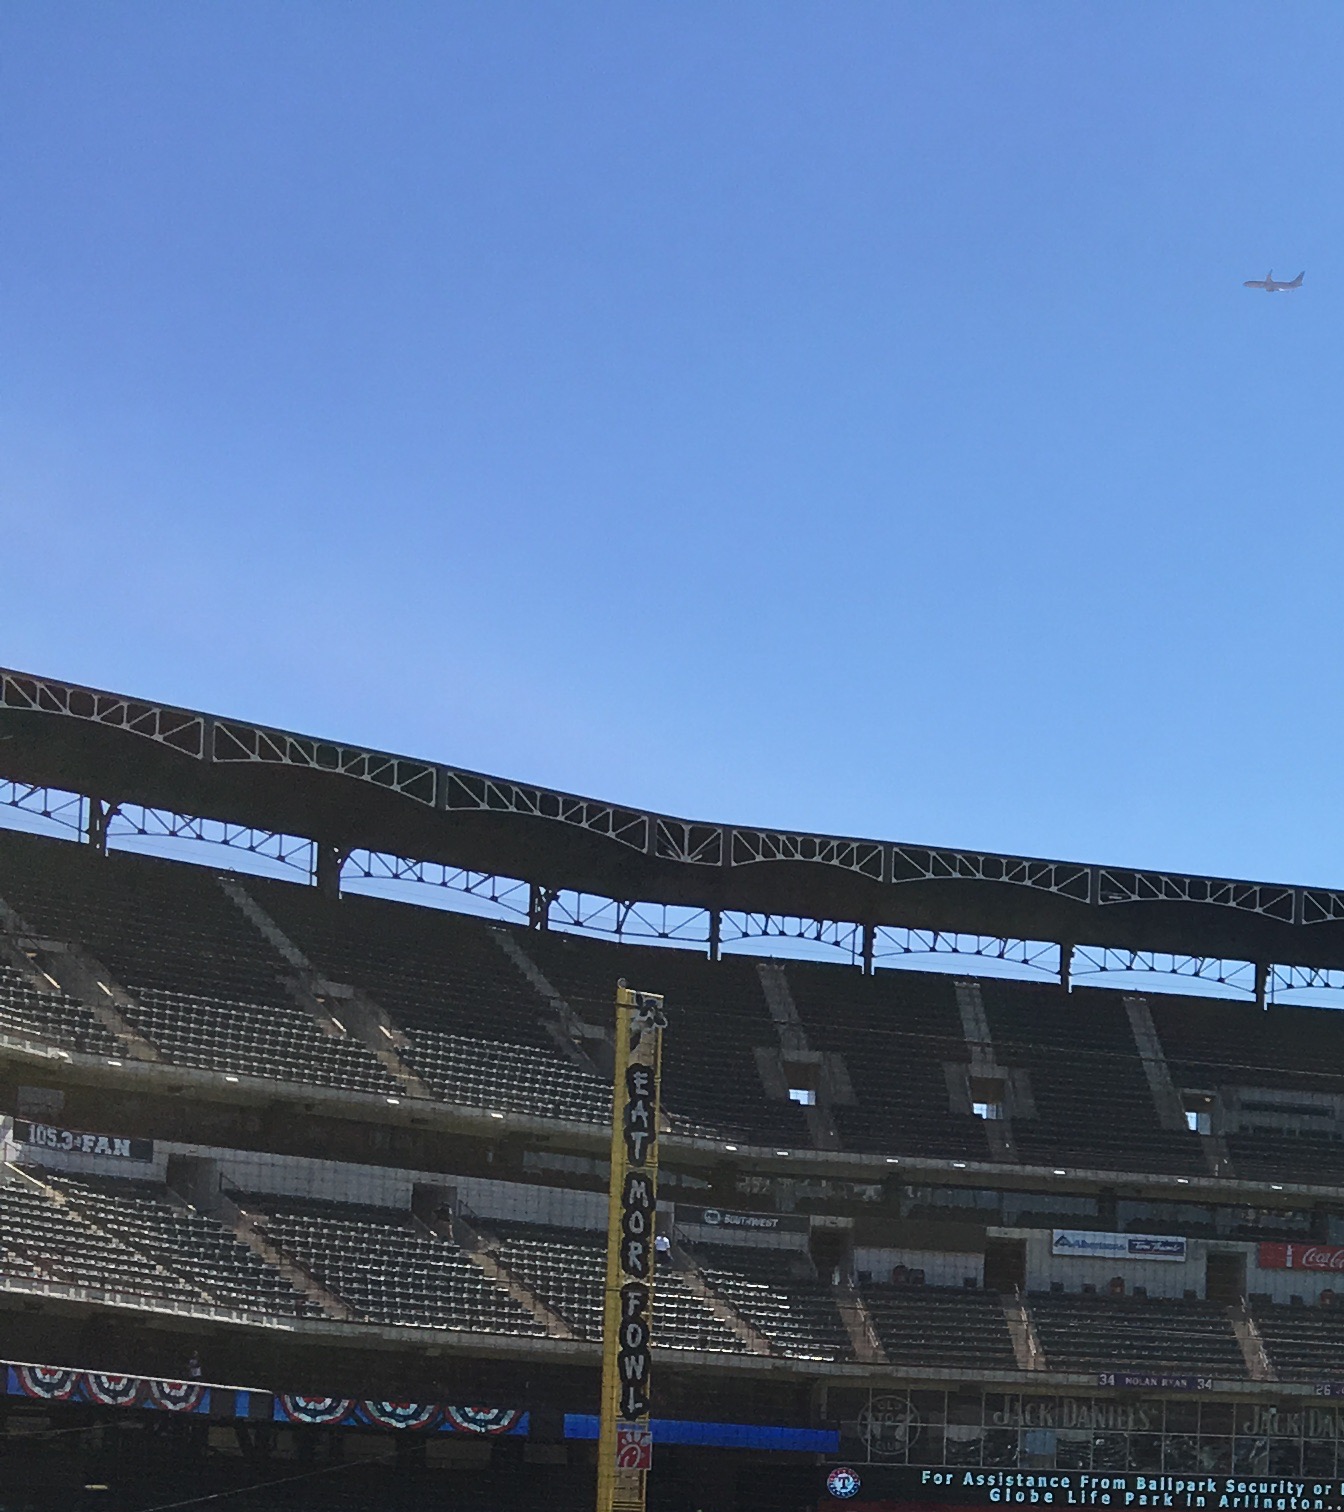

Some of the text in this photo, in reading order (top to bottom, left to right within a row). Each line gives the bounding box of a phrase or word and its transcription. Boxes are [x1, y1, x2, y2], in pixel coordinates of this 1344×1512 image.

[29, 1124, 73, 1150] 105.3
[82, 1134, 131, 1156] FAN
[624, 1070, 649, 1413] EAT MOR FOWL
[1099, 1373, 1212, 1390] 34 NOLAN RYAN 34
[1315, 1384, 1331, 1396] 26
[993, 1395, 1054, 1426] JACK
[1243, 1405, 1301, 1436] JACK
[922, 1470, 953, 1486] For
[963, 1471, 1070, 1489] Assistance
[1080, 1476, 1126, 1490] From
[1136, 1476, 1217, 1493] Ballpark
[1225, 1479, 1305, 1498] Security
[1313, 1485, 1331, 1497] or
[989, 1488, 1053, 1504] Globe
[1068, 1490, 1111, 1505] Life
[1125, 1492, 1173, 1508] Park
